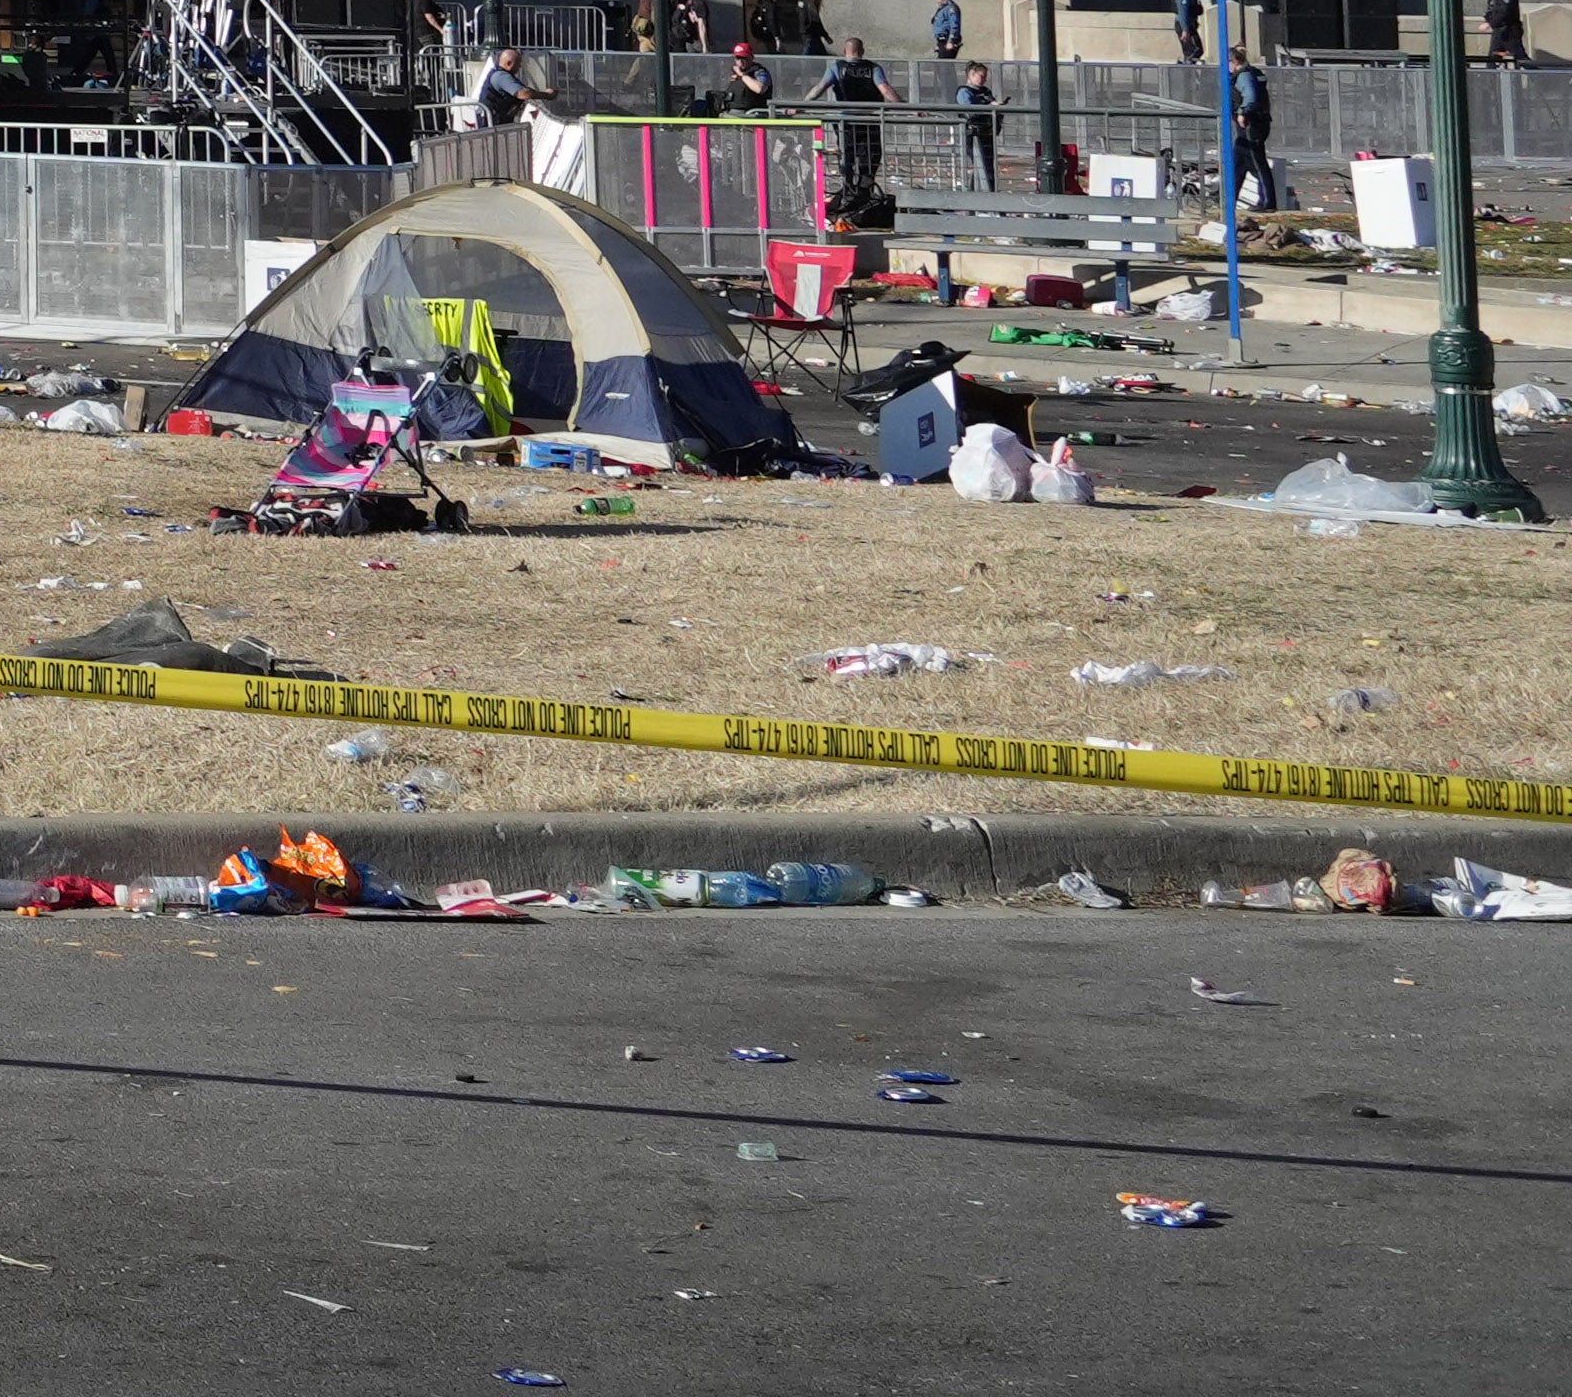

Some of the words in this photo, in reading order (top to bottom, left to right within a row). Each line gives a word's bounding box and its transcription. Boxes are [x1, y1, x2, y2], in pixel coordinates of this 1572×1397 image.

[245, 679, 299, 711] 474-TIPS
[305, 684, 335, 715] (816)
[340, 687, 388, 719] HOTLINE
[393, 690, 418, 722] TIPS
[424, 693, 452, 725] CALL
[468, 696, 507, 729] CROSS
[512, 700, 535, 731] NOT
[540, 701, 556, 733] DO
[560, 703, 585, 735] LINE
[590, 705, 630, 740] POLICE
[1222, 759, 1282, 793] 474-TIPS
[1287, 764, 1320, 796] (816)
[1326, 767, 1380, 802] HOTLINE
[1384, 771, 1412, 803] TIPS
[1417, 775, 1449, 807] CALL
[1466, 778, 1508, 812] CROSS
[1514, 782, 1540, 814] NOT
[1546, 785, 1564, 817] DO
